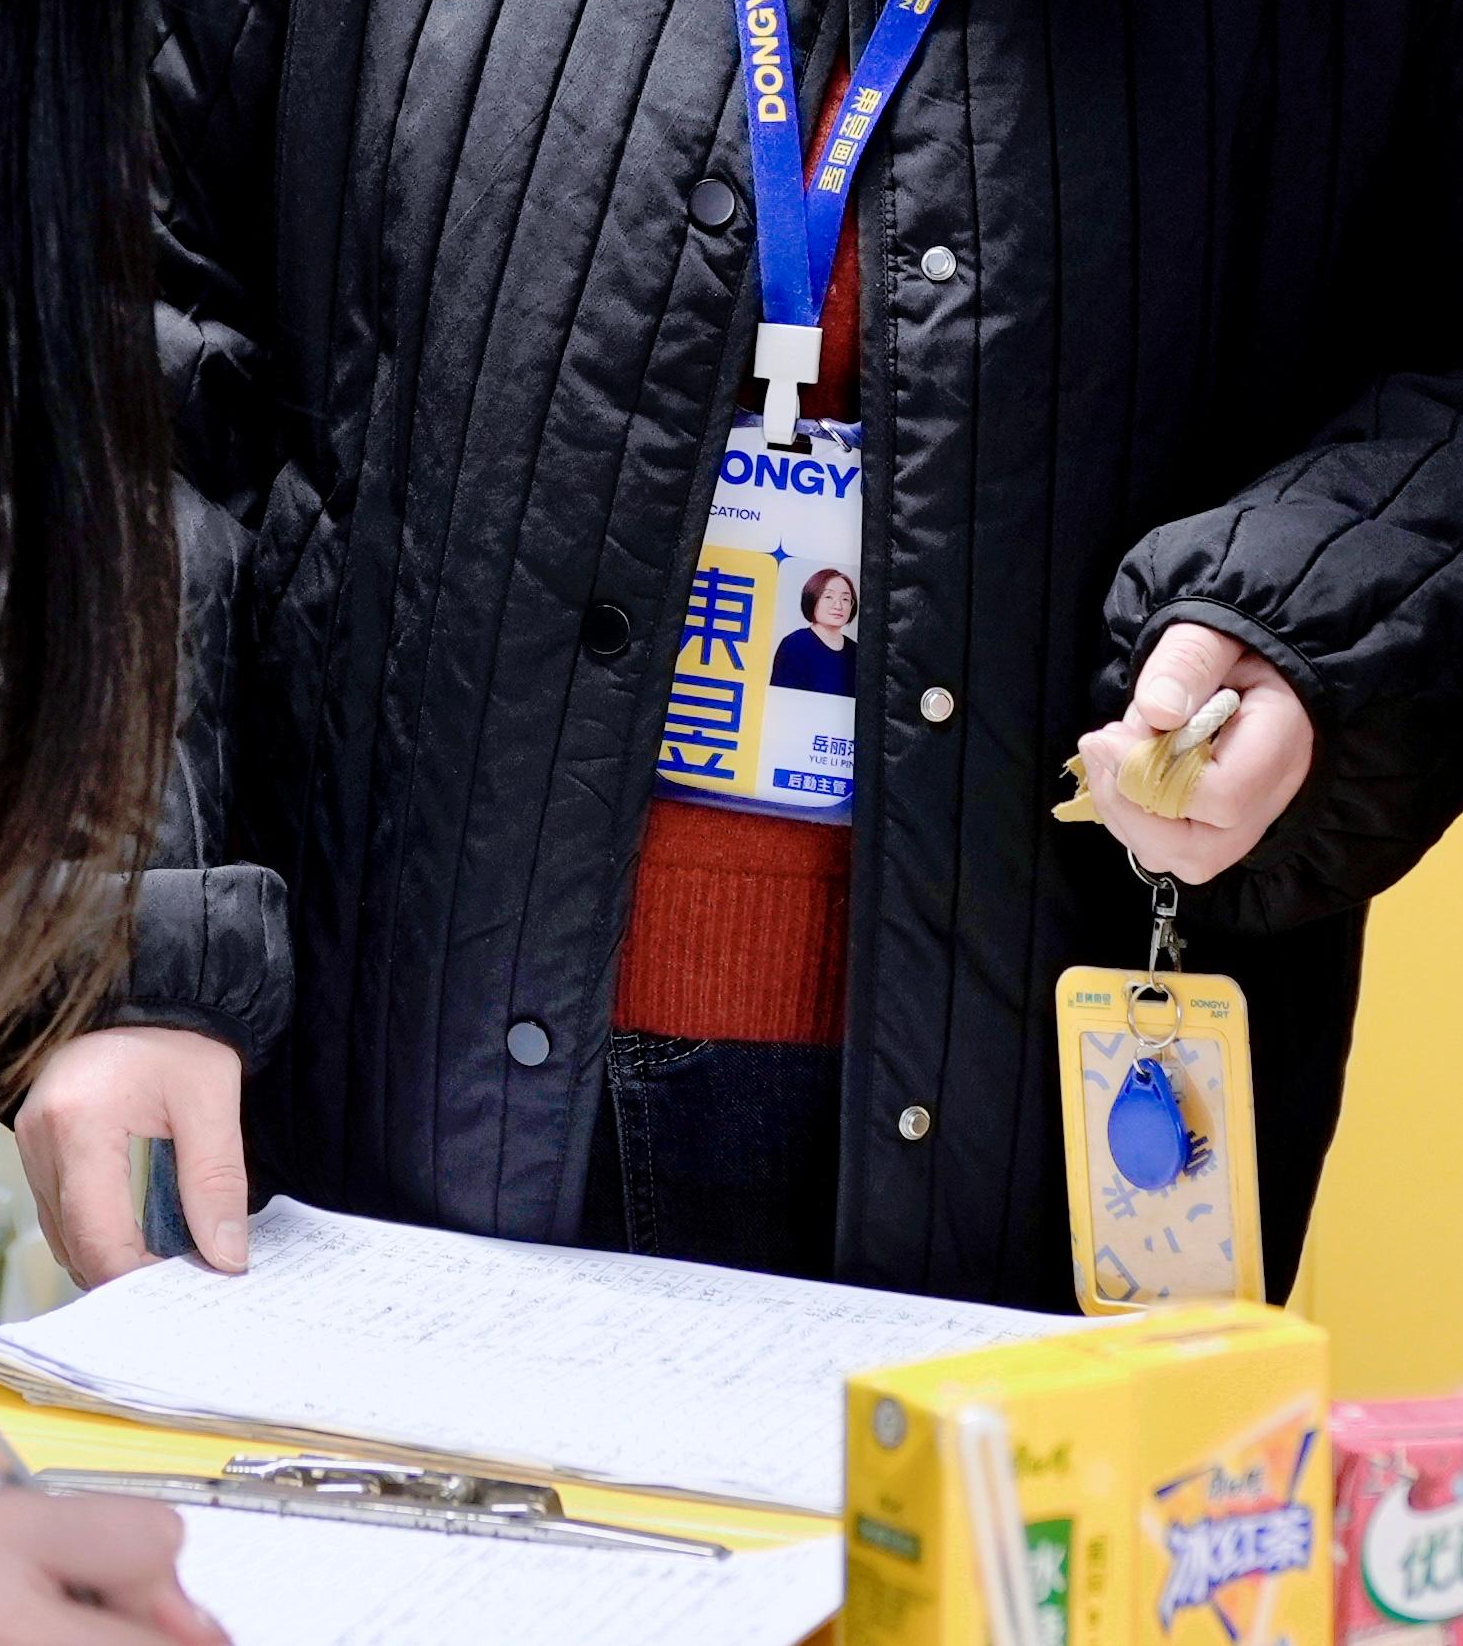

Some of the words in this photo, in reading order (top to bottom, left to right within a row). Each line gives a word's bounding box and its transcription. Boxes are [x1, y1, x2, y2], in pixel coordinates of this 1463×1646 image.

[788, 774, 847, 794] 后勤主管
[1190, 998, 1230, 1010] DONGYU
[1210, 1010, 1229, 1019] ART
